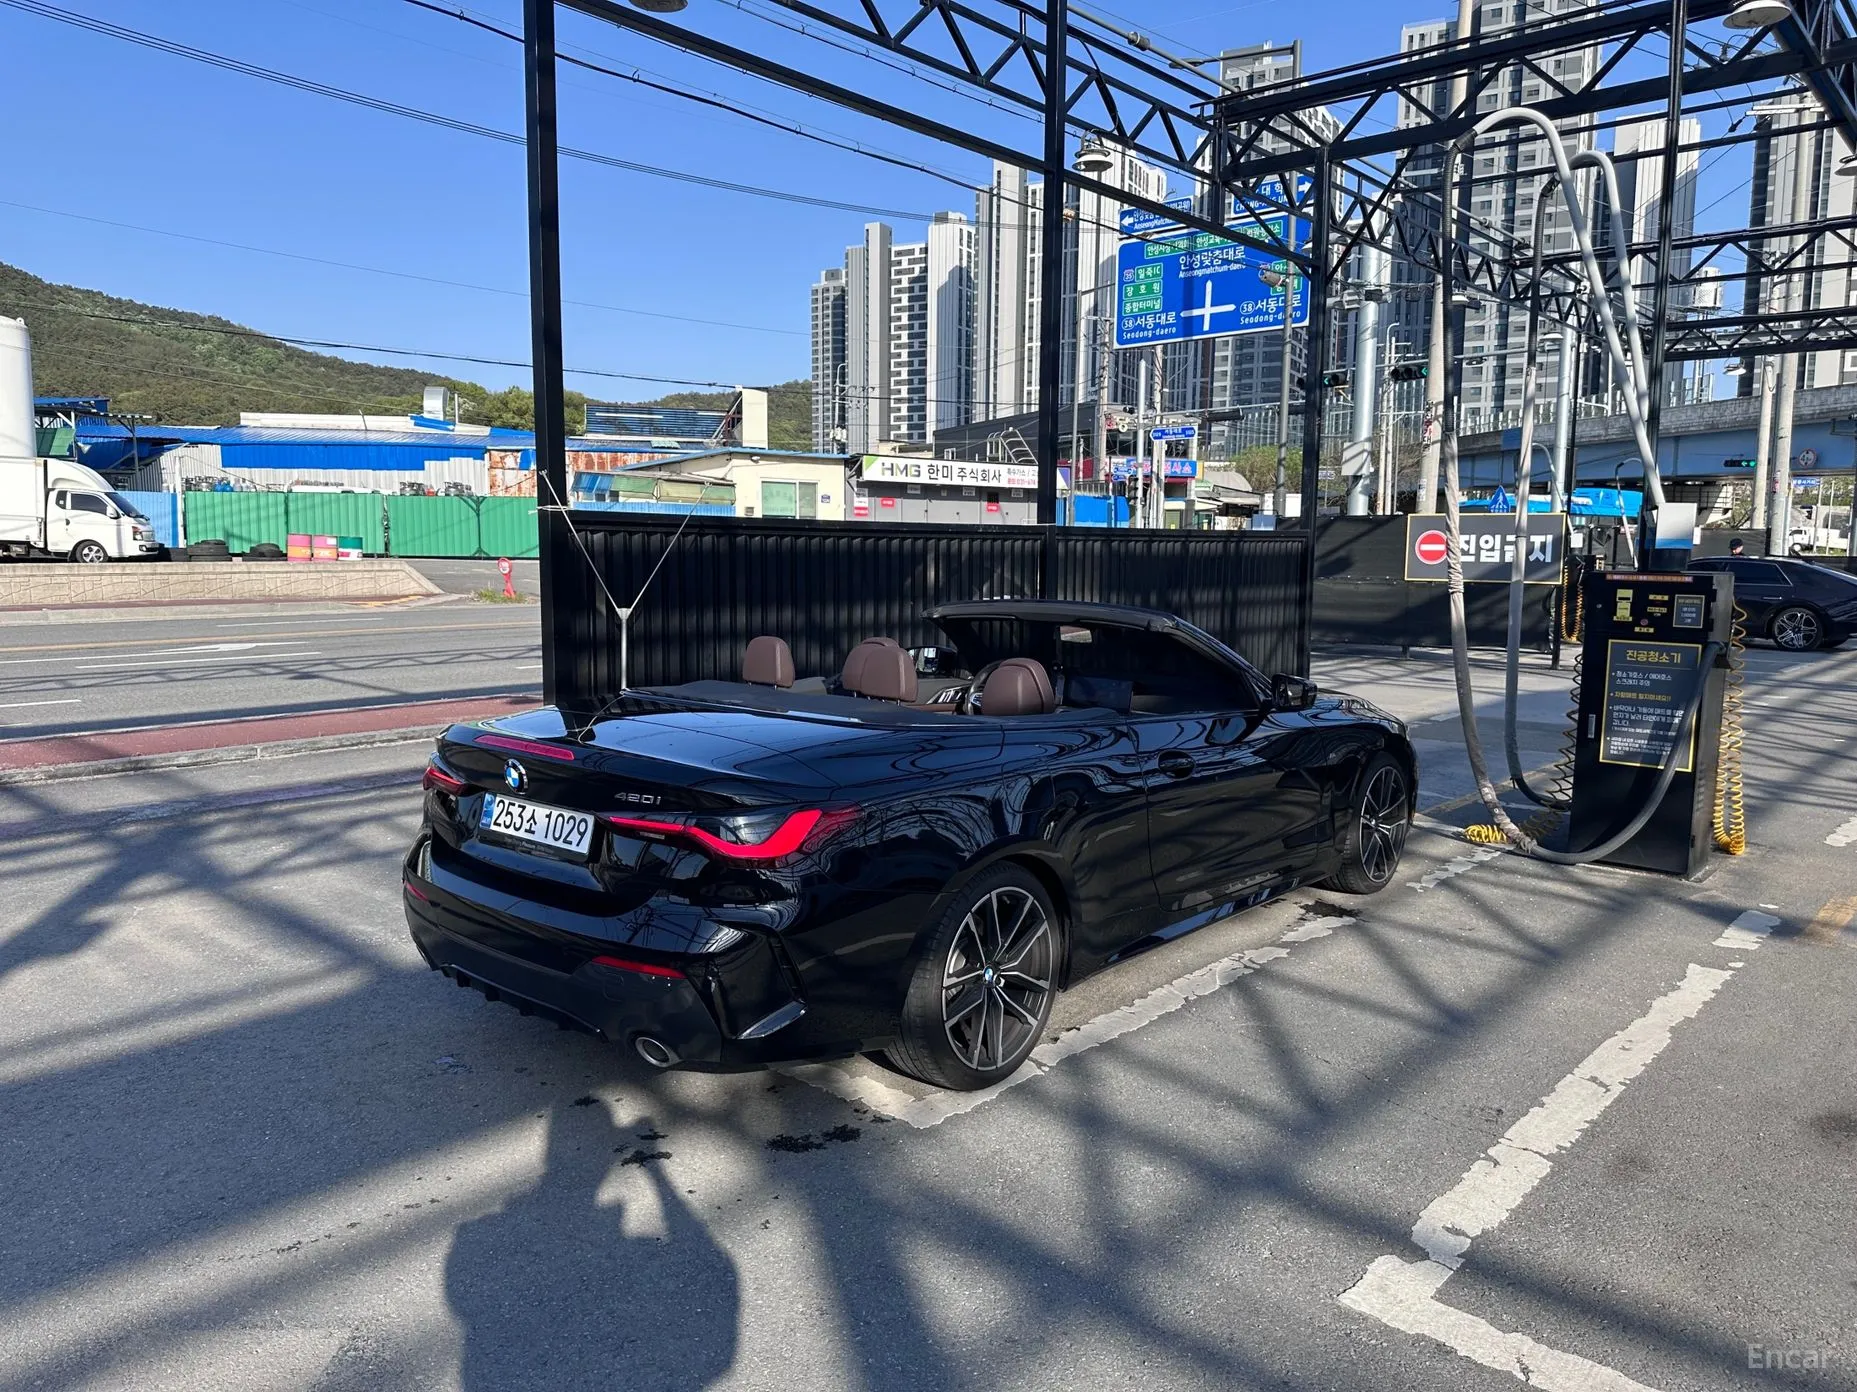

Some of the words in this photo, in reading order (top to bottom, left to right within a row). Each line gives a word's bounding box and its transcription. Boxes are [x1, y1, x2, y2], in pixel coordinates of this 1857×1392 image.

[1180, 246, 1246, 270] 안성맞춤대로
[1125, 299, 1161, 313] 종합터미널
[1242, 303, 1253, 313] 38
[1124, 320, 1133, 329] 38
[1135, 312, 1177, 329] 서동대로
[881, 462, 921, 478] HMG
[927, 463, 953, 482] 한미
[957, 467, 1001, 483] 주식회사
[1626, 649, 1682, 664] 진공청소기
[614, 792, 662, 805] 420i
[492, 799, 538, 836] 253소
[544, 810, 589, 848] 1029
